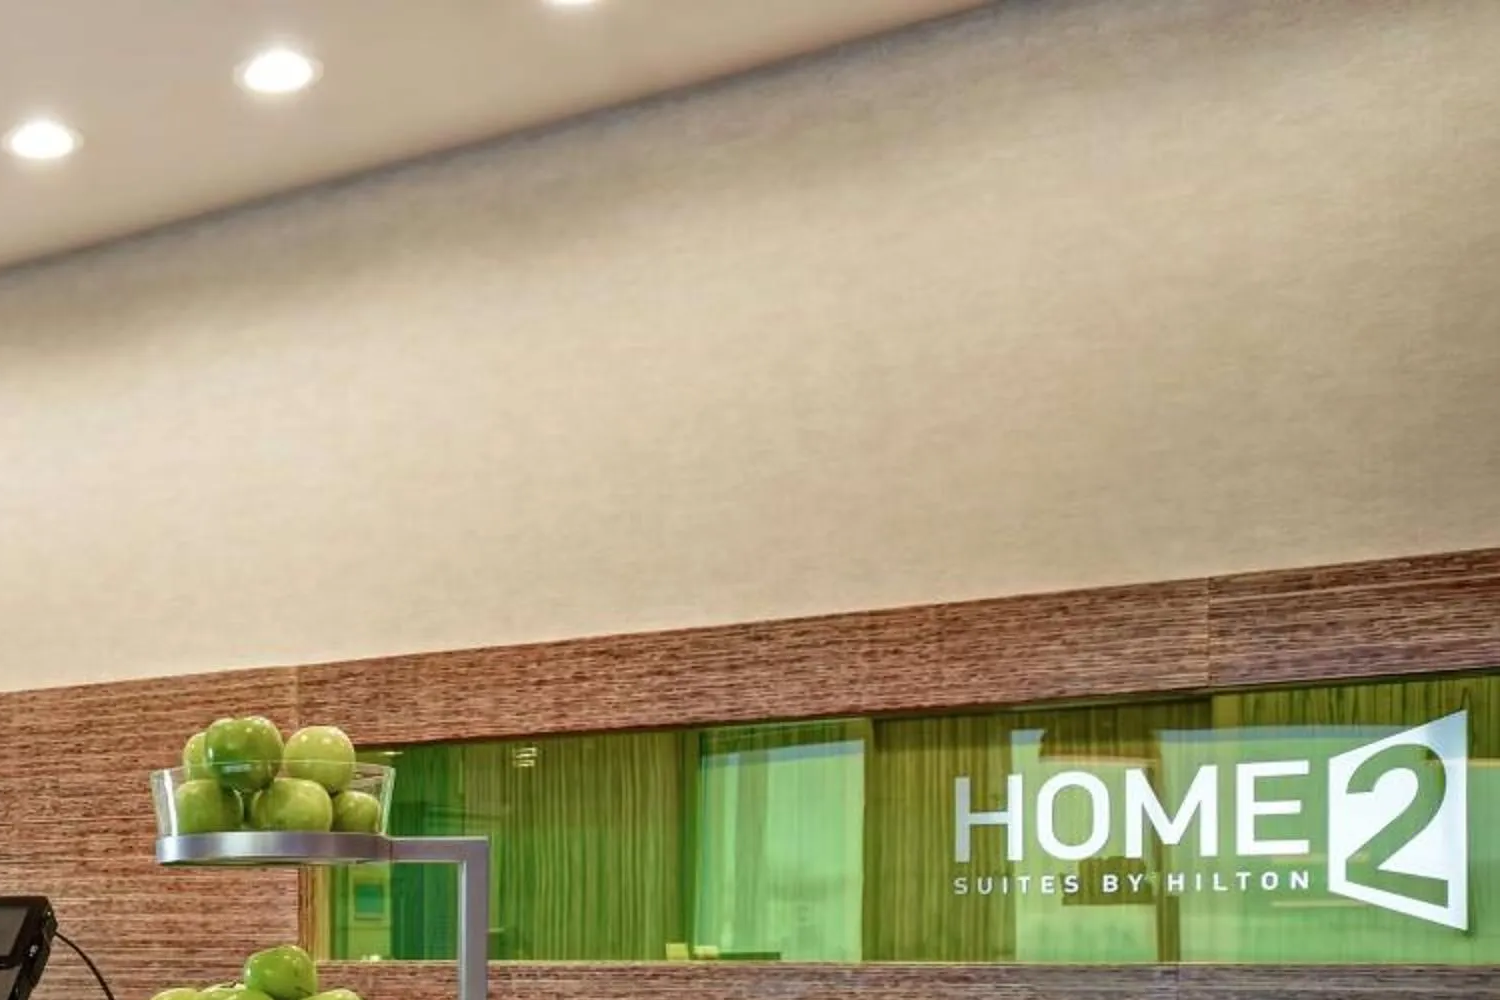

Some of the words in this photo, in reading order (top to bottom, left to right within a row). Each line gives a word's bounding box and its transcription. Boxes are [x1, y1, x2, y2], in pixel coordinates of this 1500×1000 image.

[954, 760, 1311, 863] HOME
[1342, 741, 1451, 911] 2
[953, 873, 1080, 896] SUITES
[1102, 873, 1146, 893] BY
[1167, 870, 1311, 892] HILTON
